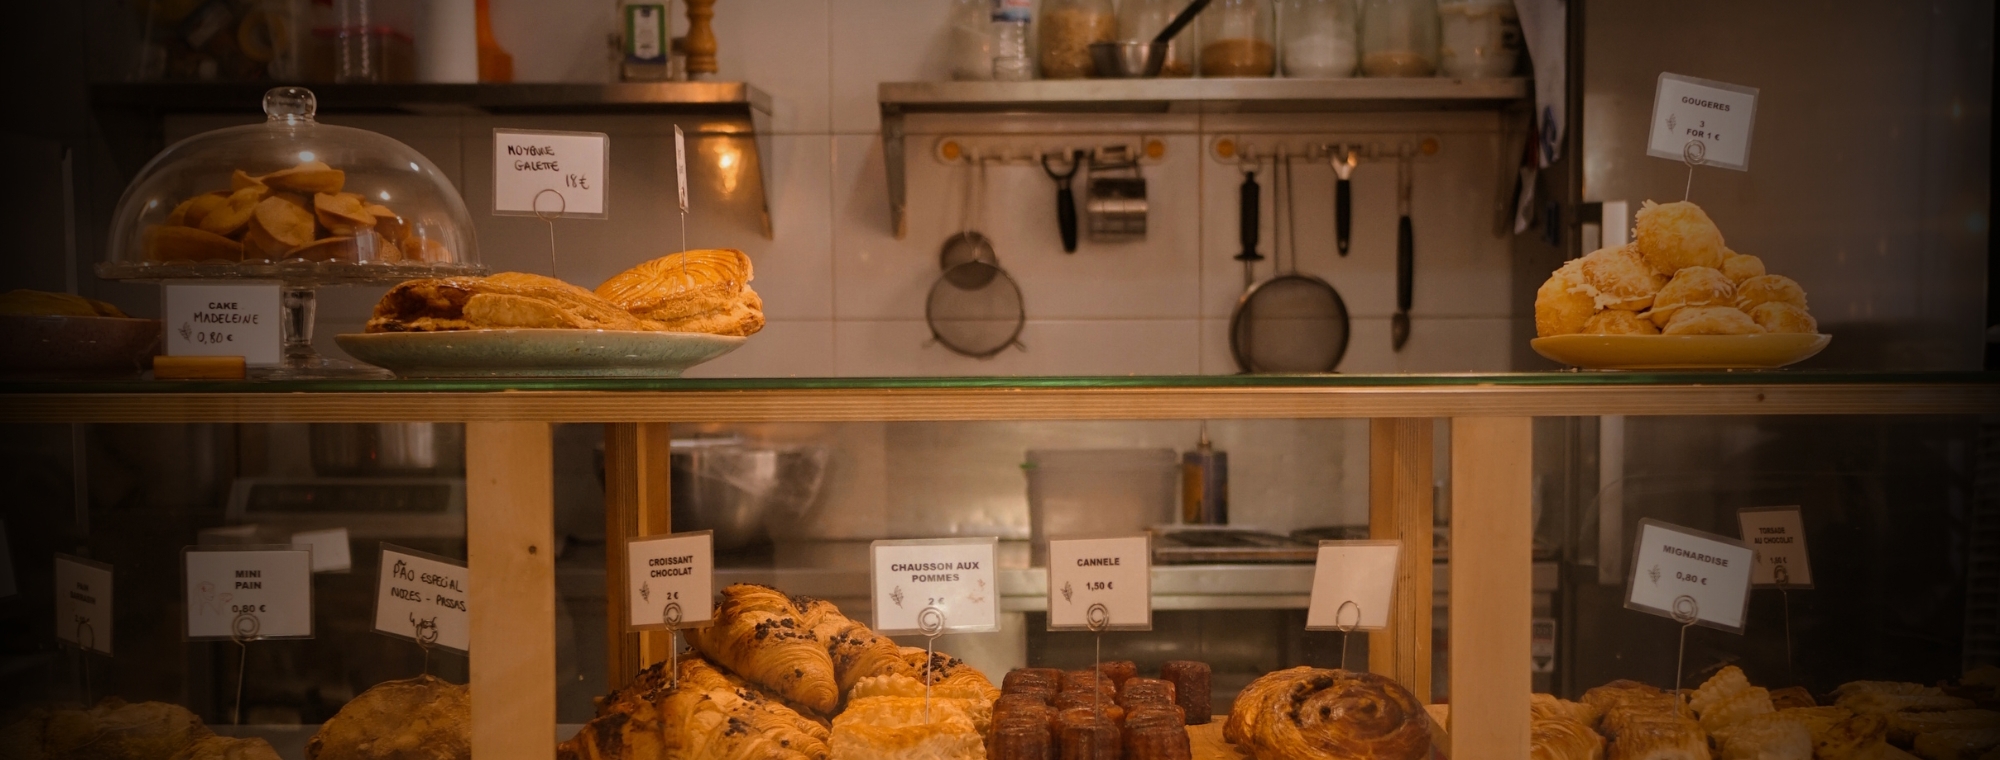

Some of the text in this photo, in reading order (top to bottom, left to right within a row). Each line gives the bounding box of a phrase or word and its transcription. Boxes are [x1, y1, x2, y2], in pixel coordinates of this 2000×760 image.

[1682, 96, 1730, 112] GOUGERES
[1699, 120, 1705, 128] 3
[1686, 128, 1704, 138] FOR
[1714, 133, 1720, 141] €
[514, 160, 559, 171] GALETTE
[208, 302, 238, 310] CAKE
[194, 311, 259, 325] MADELEINE
[197, 331, 233, 345] 0,80 €
[1763, 536, 1793, 544] CHOCOLAT
[648, 555, 694, 567] CROISSANT
[1662, 544, 1729, 568] MIGNARDISE
[891, 561, 980, 572] CHAUSSON AUX
[1076, 557, 1120, 567] CANNELE
[235, 570, 261, 578] MINI
[393, 560, 415, 581] PÃO
[650, 566, 692, 578] CHOCOLAT
[911, 573, 960, 582] POMMES
[1676, 571, 1707, 585] 0,80 €
[235, 581, 262, 589] PAIN
[1086, 581, 1113, 591] 1,50 €
[391, 587, 422, 603] NOZES
[436, 594, 466, 612] PASSAS
[666, 591, 679, 600] 2 €
[928, 597, 935, 606] 2
[231, 604, 266, 614] 0,80 €
